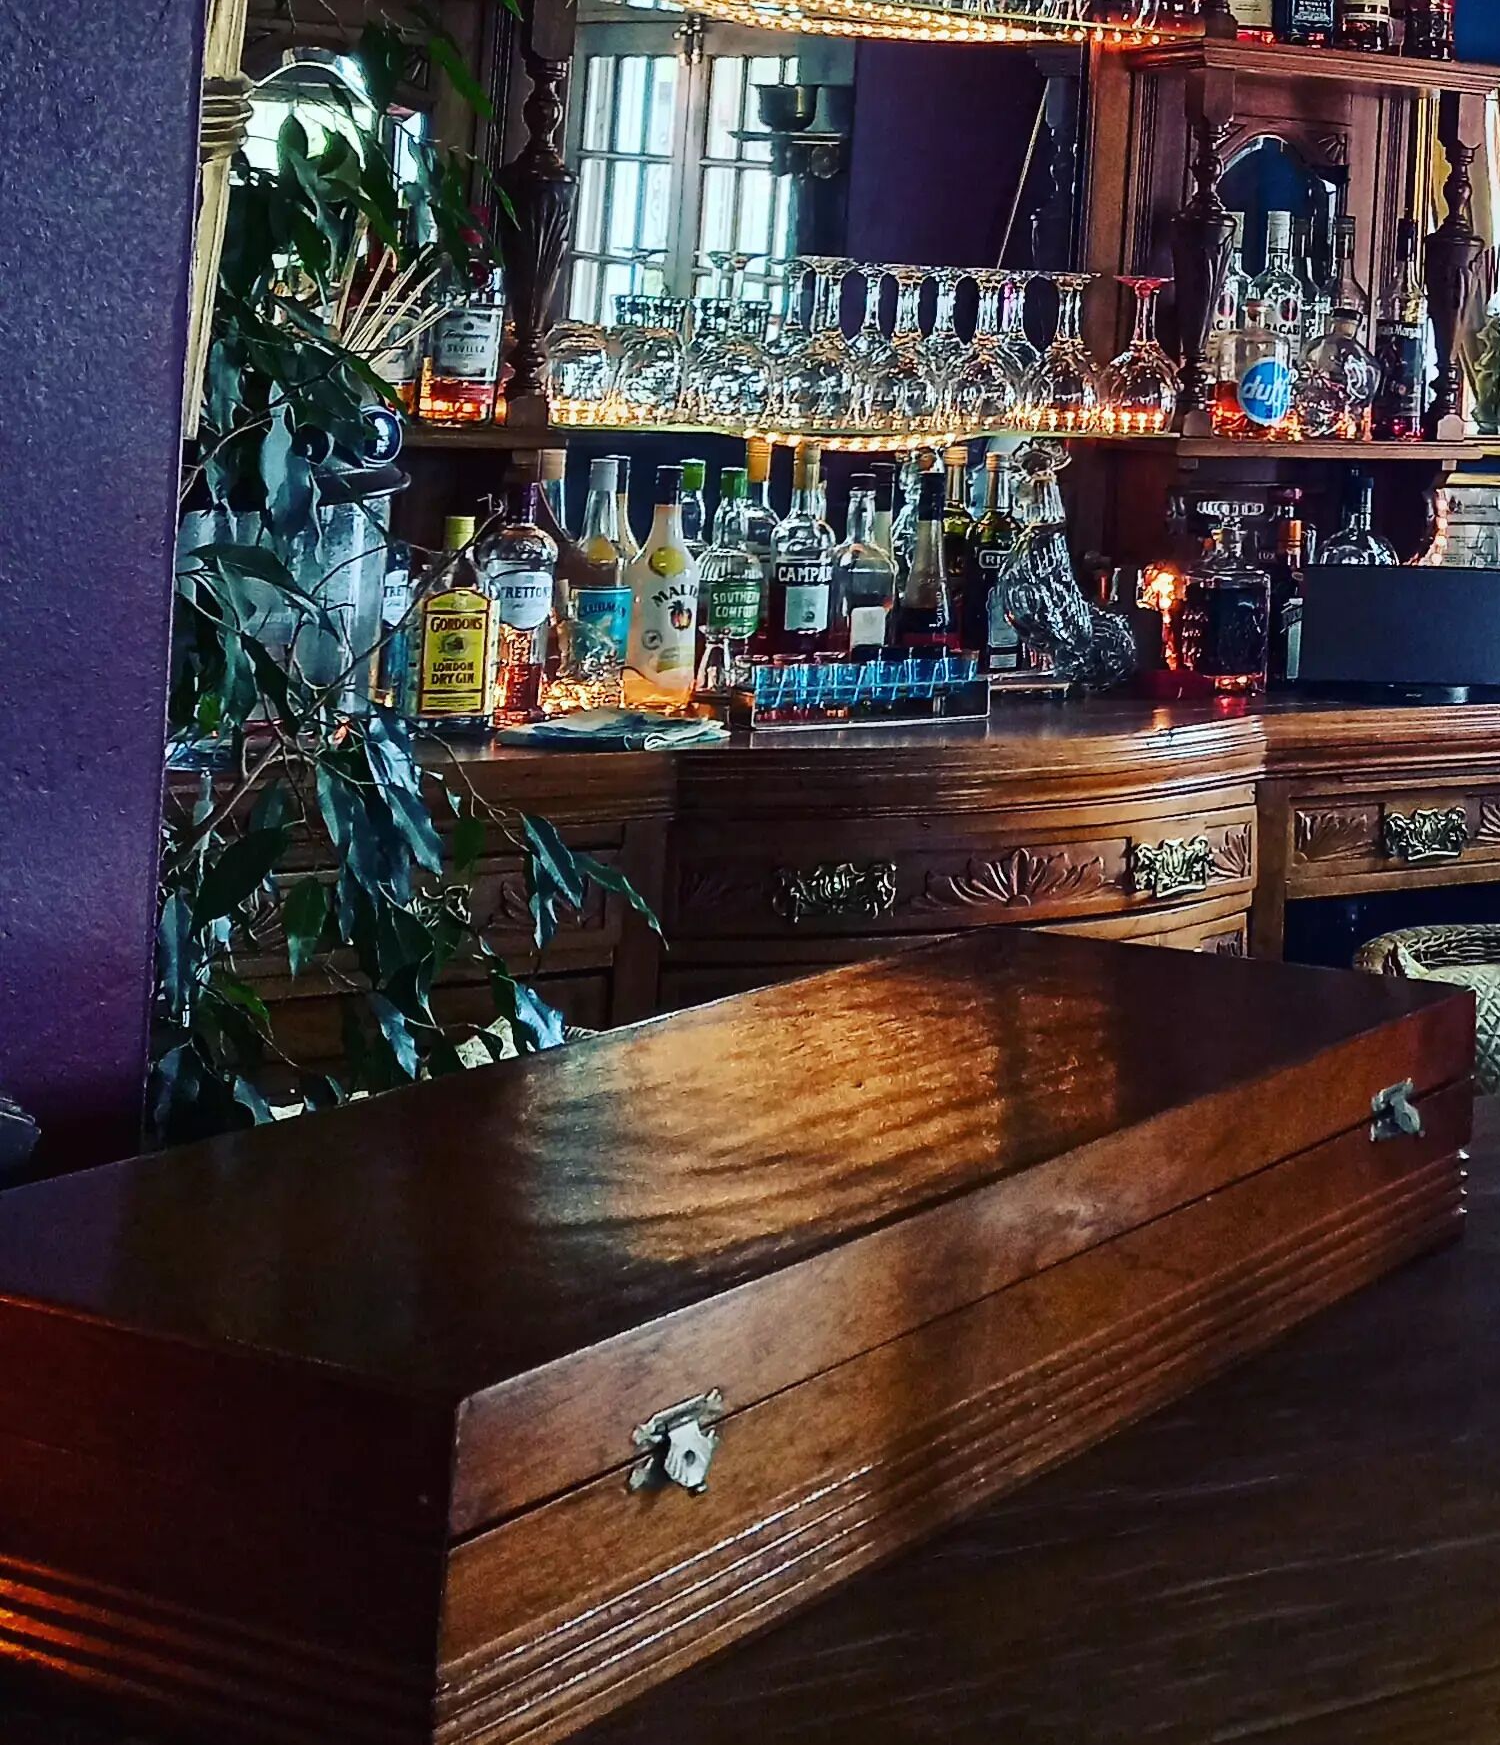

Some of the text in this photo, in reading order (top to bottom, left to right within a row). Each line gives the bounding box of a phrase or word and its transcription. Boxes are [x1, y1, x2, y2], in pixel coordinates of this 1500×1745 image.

[432, 661, 474, 672] LONDON
[431, 672, 475, 685] DRY GIN
